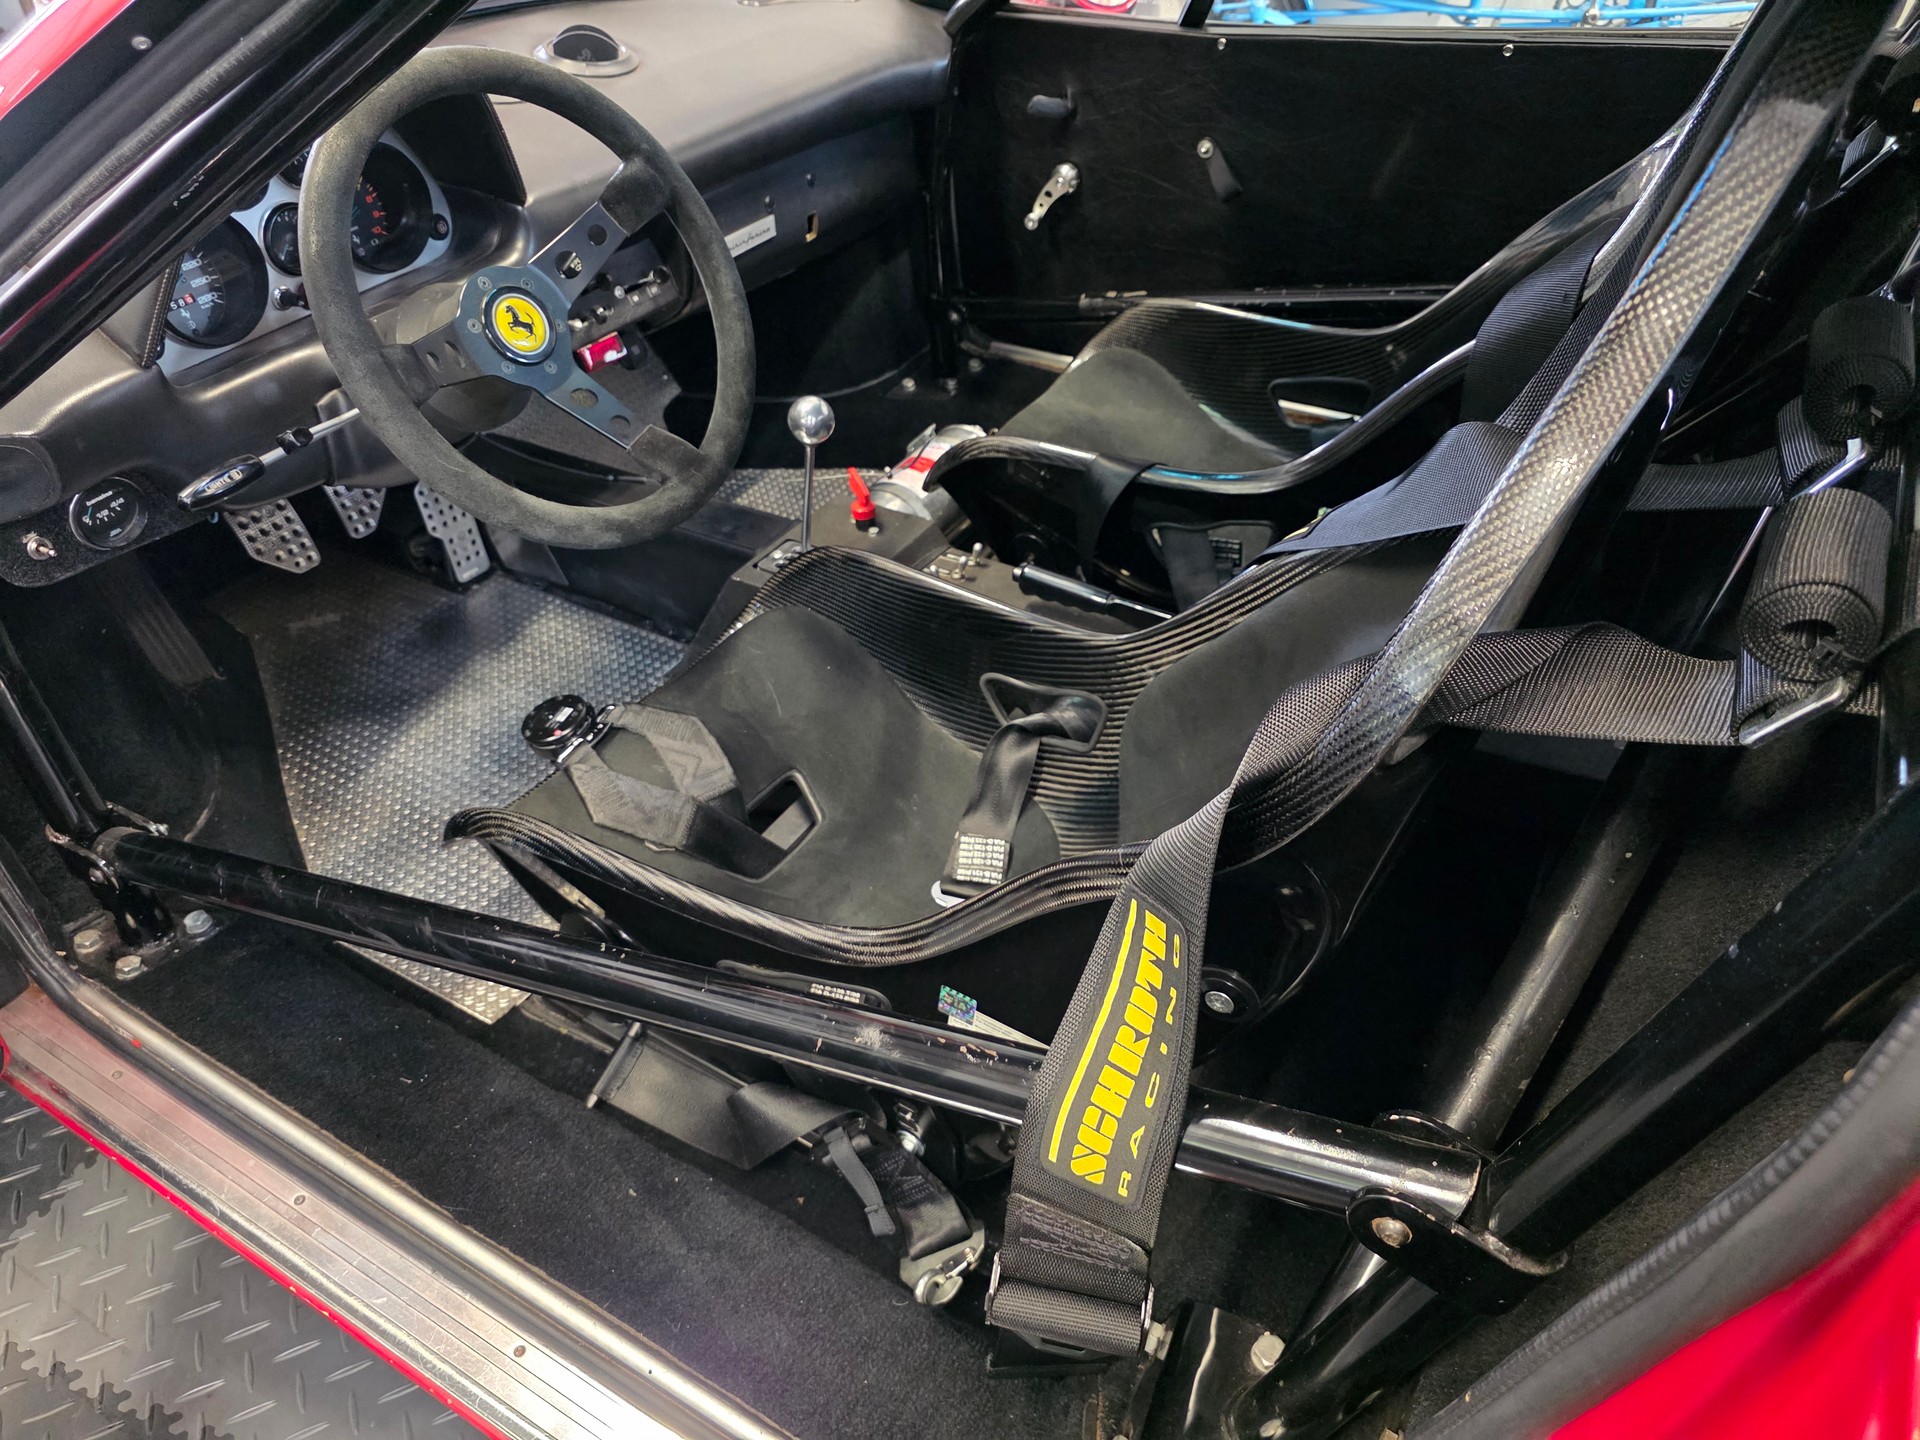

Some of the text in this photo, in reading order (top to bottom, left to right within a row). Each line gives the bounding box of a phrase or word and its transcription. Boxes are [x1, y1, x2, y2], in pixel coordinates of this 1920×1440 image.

[181, 258, 202, 271] 220
[190, 275, 211, 288] 250
[197, 292, 218, 304] 280
[1070, 910, 1166, 1184] SCHROTH
[1118, 934, 1180, 1197] RACING
